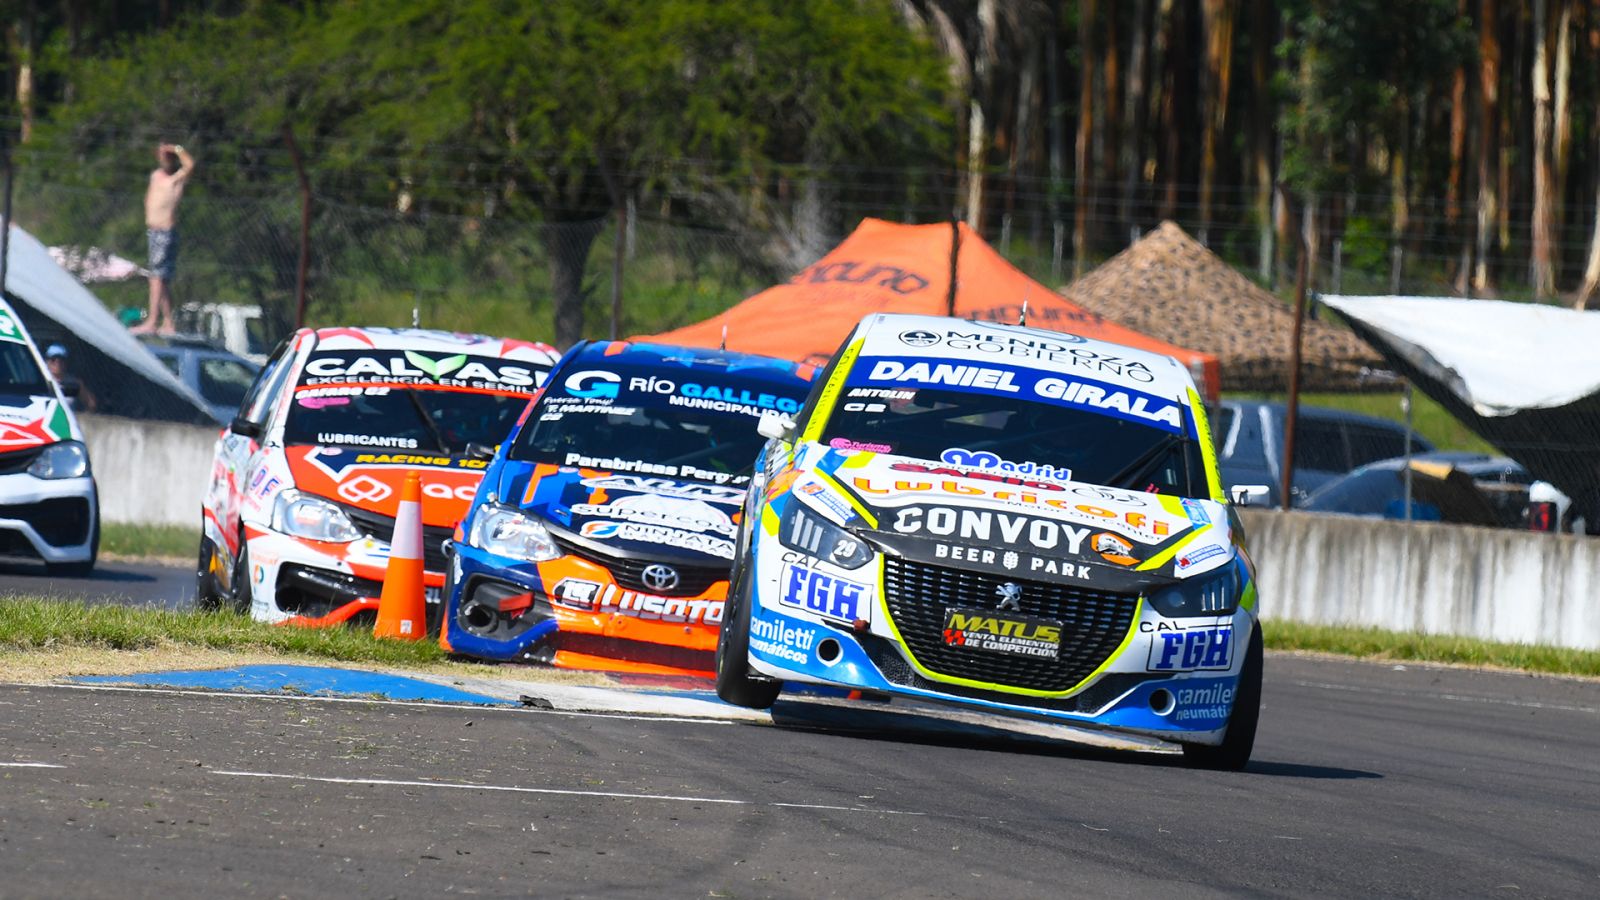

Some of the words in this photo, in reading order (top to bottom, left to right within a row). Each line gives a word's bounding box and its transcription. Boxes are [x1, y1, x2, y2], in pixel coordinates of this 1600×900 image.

[946, 331, 1152, 372] MENDOZA
[946, 339, 1155, 383] GOBIERNO
[306, 375, 434, 386] EXCELENCIA
[439, 378, 466, 387] EN
[629, 376, 675, 395] RÍO
[847, 388, 916, 400] ANTOLIN
[868, 361, 1020, 393] DANIEL
[1033, 378, 1182, 428] GIRALA
[669, 395, 791, 419] MUNICIPALIDA
[318, 433, 418, 448] LUBRICANTES
[355, 455, 451, 467] RACING
[459, 459, 488, 469] 10
[565, 453, 678, 476] Parabrisas
[942, 450, 1071, 480] Madrid
[893, 507, 1092, 555] CONVOY
[834, 540, 857, 558] 29
[782, 552, 822, 569] CAL
[935, 545, 995, 565] BEER
[1030, 557, 1091, 580] PARK
[784, 565, 865, 621] FGH
[750, 616, 816, 650] amiletti
[947, 613, 1061, 643] MATUS
[1140, 621, 1186, 633] CAL
[963, 631, 996, 641] VENTA
[999, 636, 1059, 650] ELEMENTOS
[965, 638, 980, 647] DE
[1156, 629, 1231, 669] FGH
[1178, 683, 1237, 705] camilet
[1176, 705, 1227, 720] neumáti
